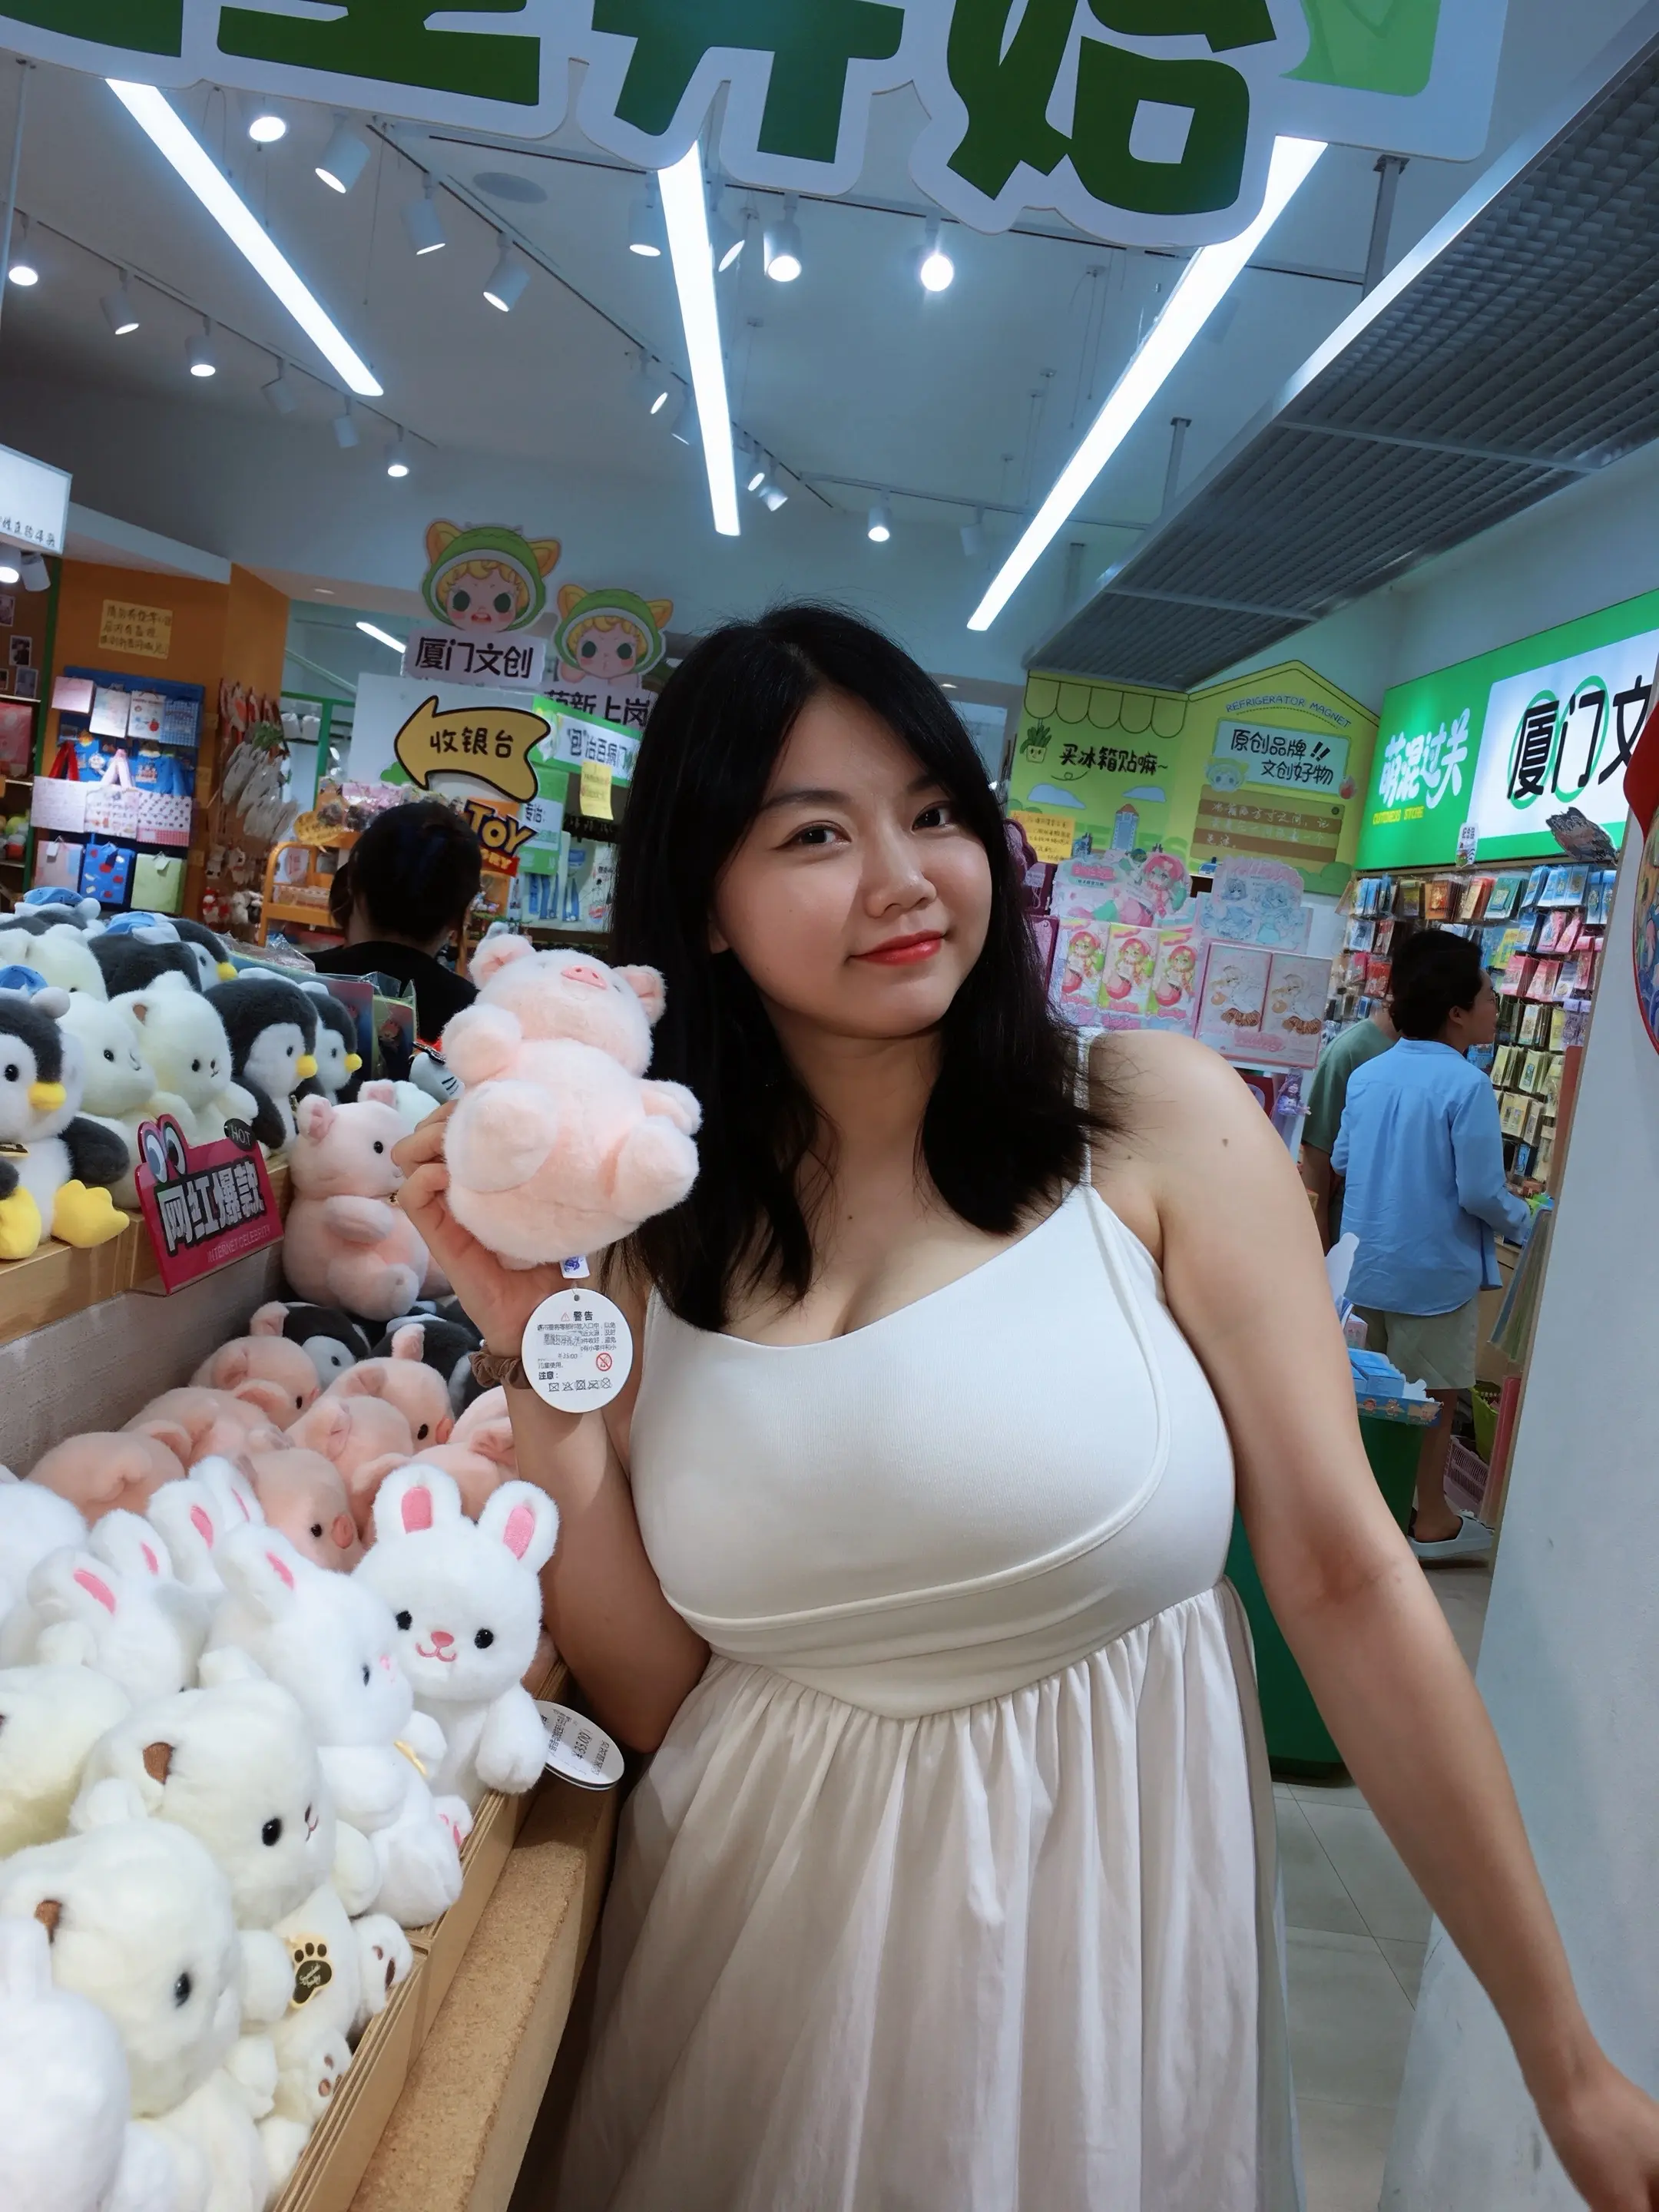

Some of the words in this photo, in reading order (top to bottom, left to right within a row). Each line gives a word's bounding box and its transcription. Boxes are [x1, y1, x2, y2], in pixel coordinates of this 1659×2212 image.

[416, 637, 533, 679] 厦门文创
[1226, 695, 1306, 713] REFRIGERATOR
[1310, 702, 1352, 728] MAGNET
[430, 727, 514, 759] 收银台
[1379, 708, 1470, 809] 萌混过关
[1261, 759, 1334, 786] 文创好物
[465, 800, 538, 857] TOY
[230, 1124, 250, 1146] HOT
[157, 1161, 265, 1252] 网红爆款
[573, 1310, 594, 1321] 警告
